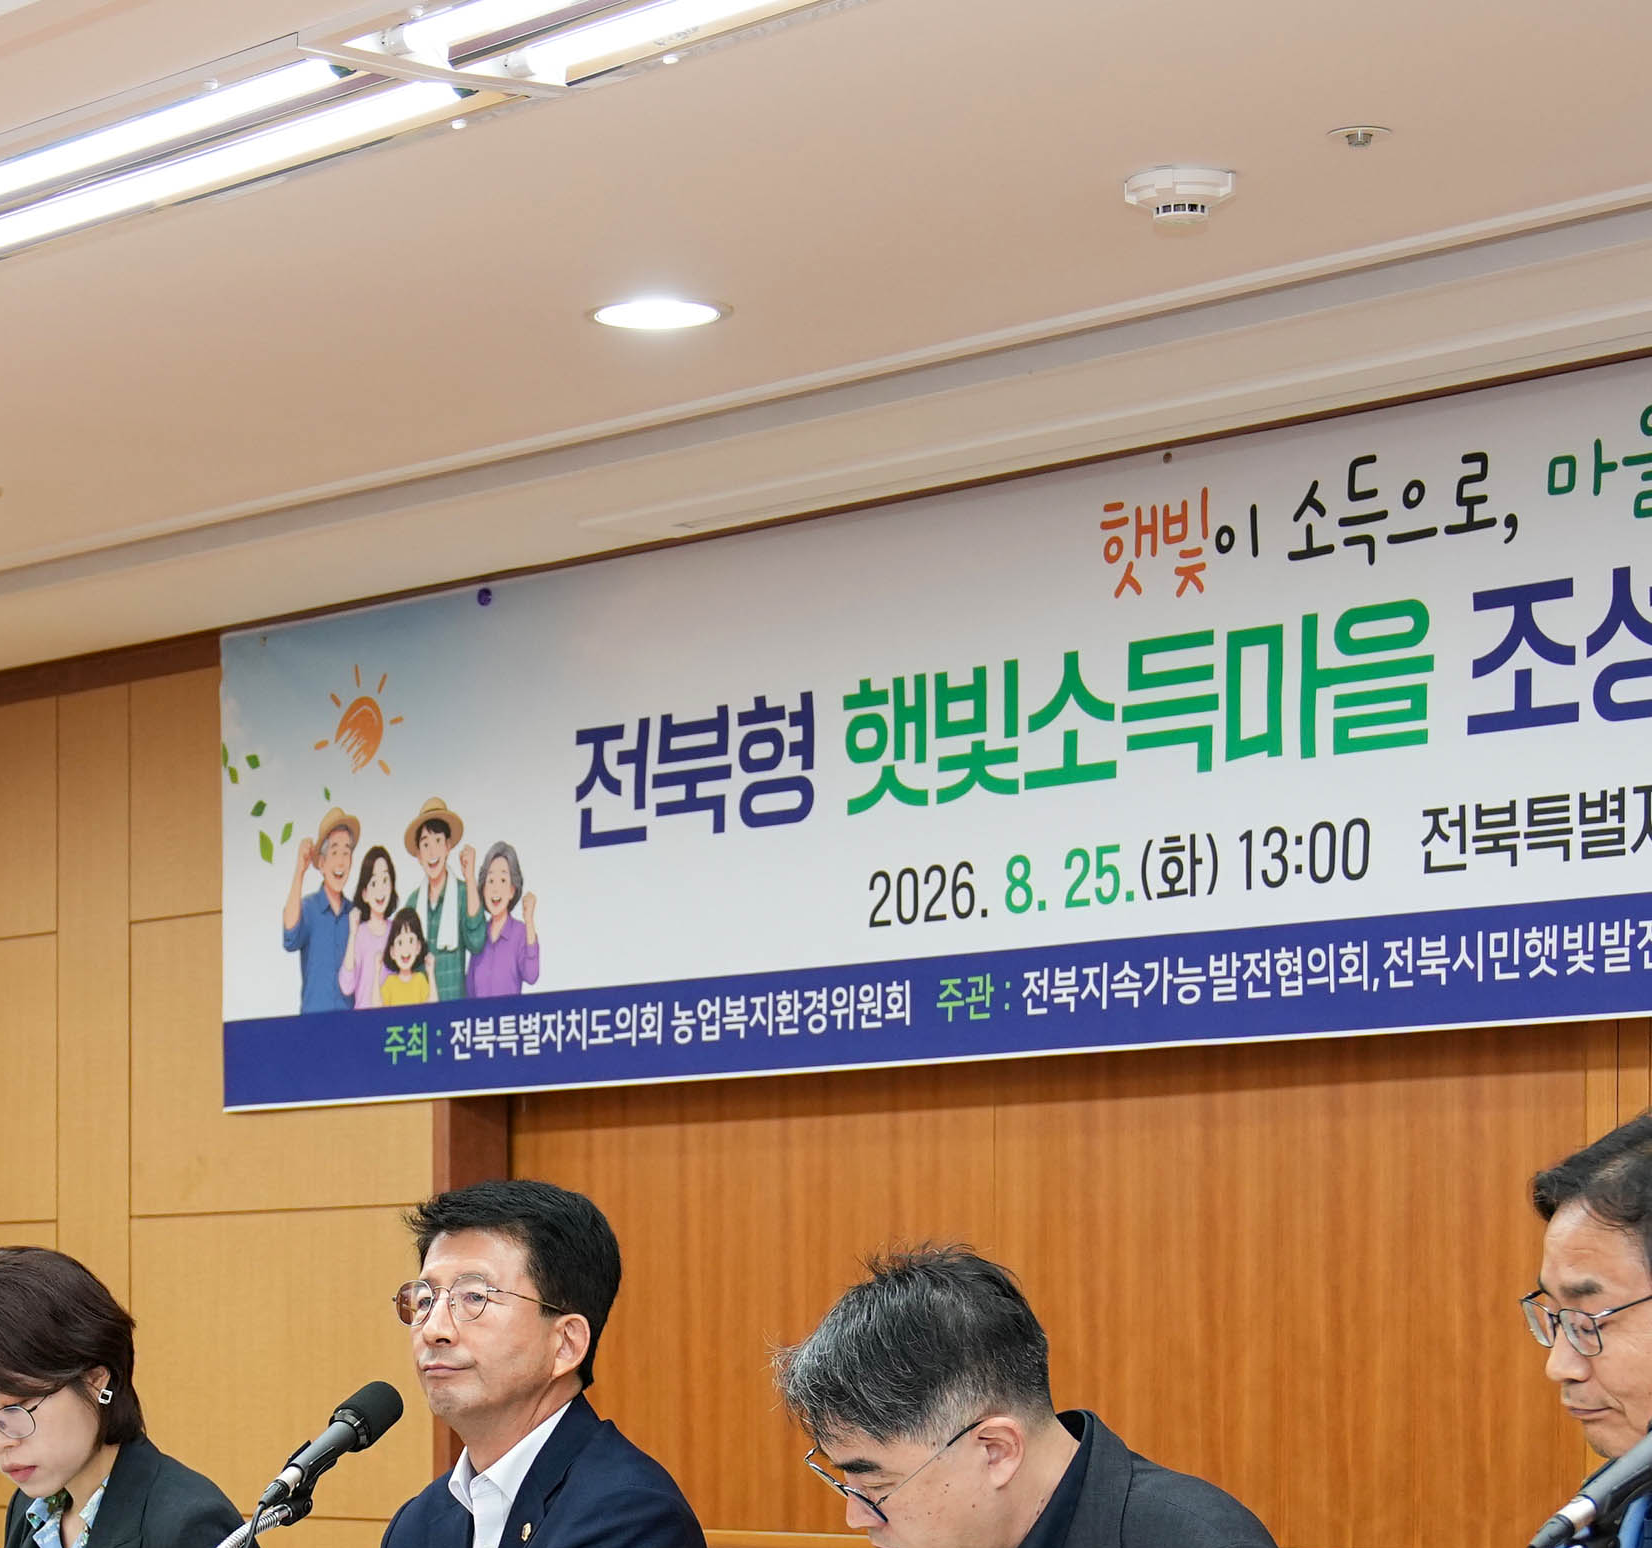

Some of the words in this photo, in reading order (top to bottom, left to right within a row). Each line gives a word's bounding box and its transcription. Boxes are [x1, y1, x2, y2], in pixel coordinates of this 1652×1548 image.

[1100, 486, 1258, 598] 햇빛이
[1286, 452, 1519, 566] 소득으로,
[573, 690, 818, 850] 전북형
[845, 598, 1434, 816] 햇빛소득마을
[869, 862, 991, 928] 2026.
[1004, 855, 1047, 915] 8.
[1237, 818, 1371, 884] 13:00
[384, 1022, 428, 1064] 주최
[450, 1000, 663, 1062] 전북특별자치도의회
[671, 980, 912, 1045] 농업복지환경위원회
[936, 973, 995, 1022] 주관
